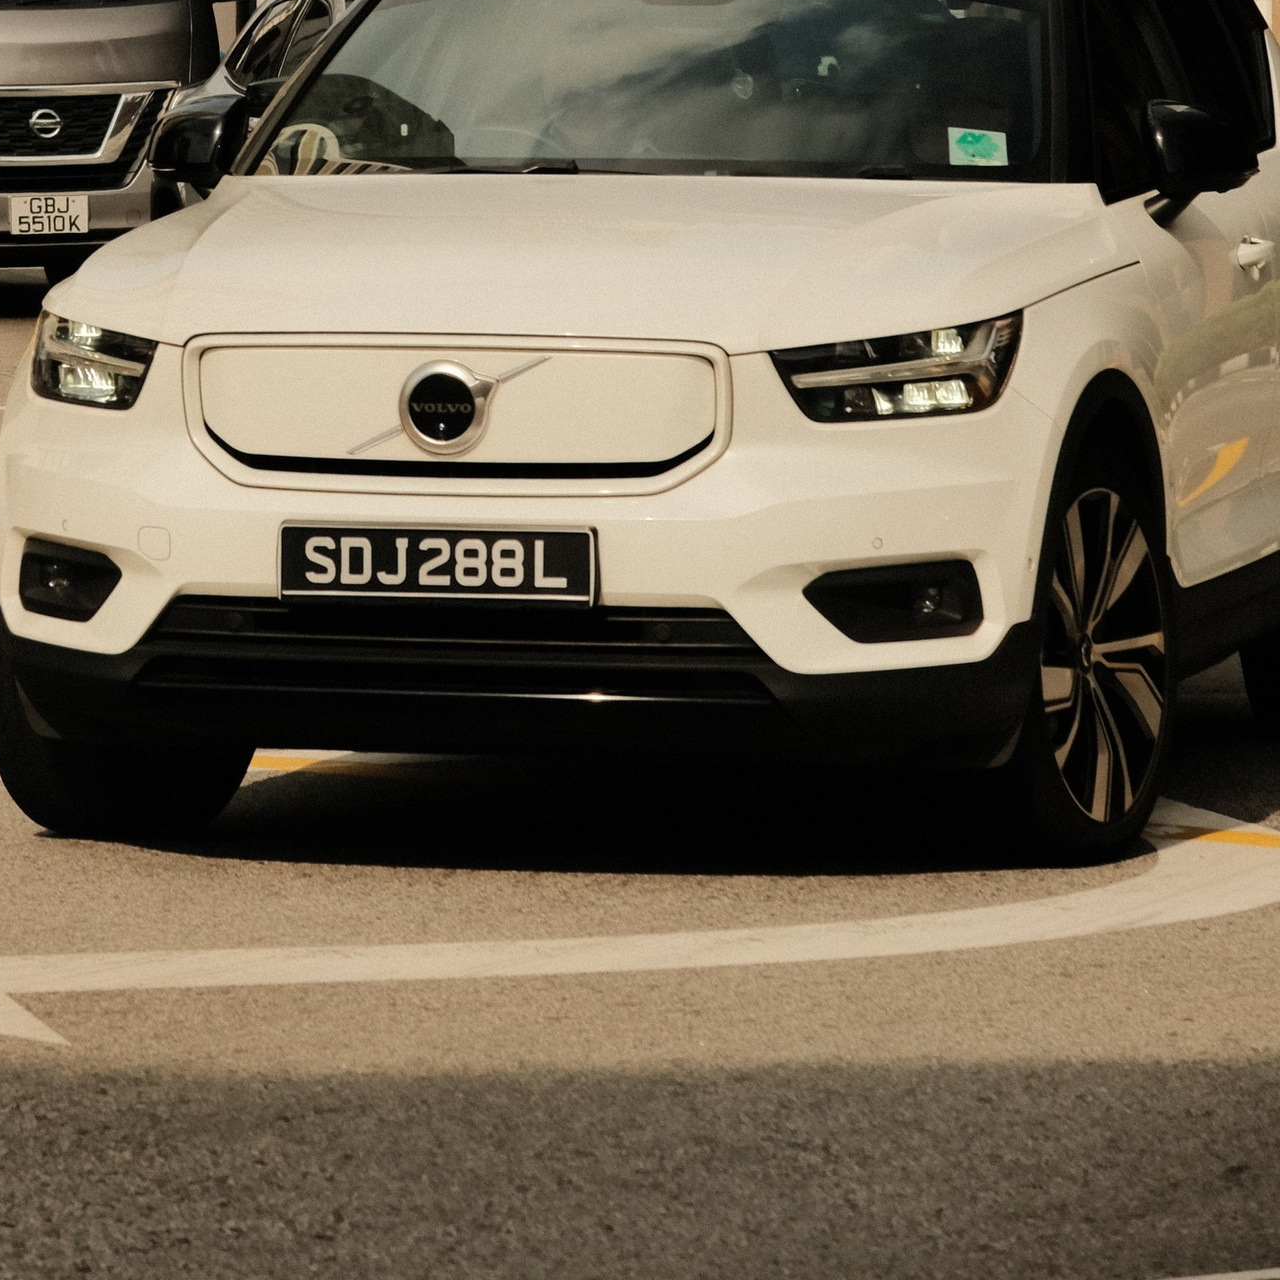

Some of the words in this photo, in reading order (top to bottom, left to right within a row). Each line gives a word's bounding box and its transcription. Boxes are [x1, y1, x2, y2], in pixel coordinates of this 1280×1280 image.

[29, 197, 69, 214] GBJ
[18, 215, 80, 233] 5510K
[411, 403, 472, 413] VOLVO
[305, 536, 567, 588] SDJ288L
